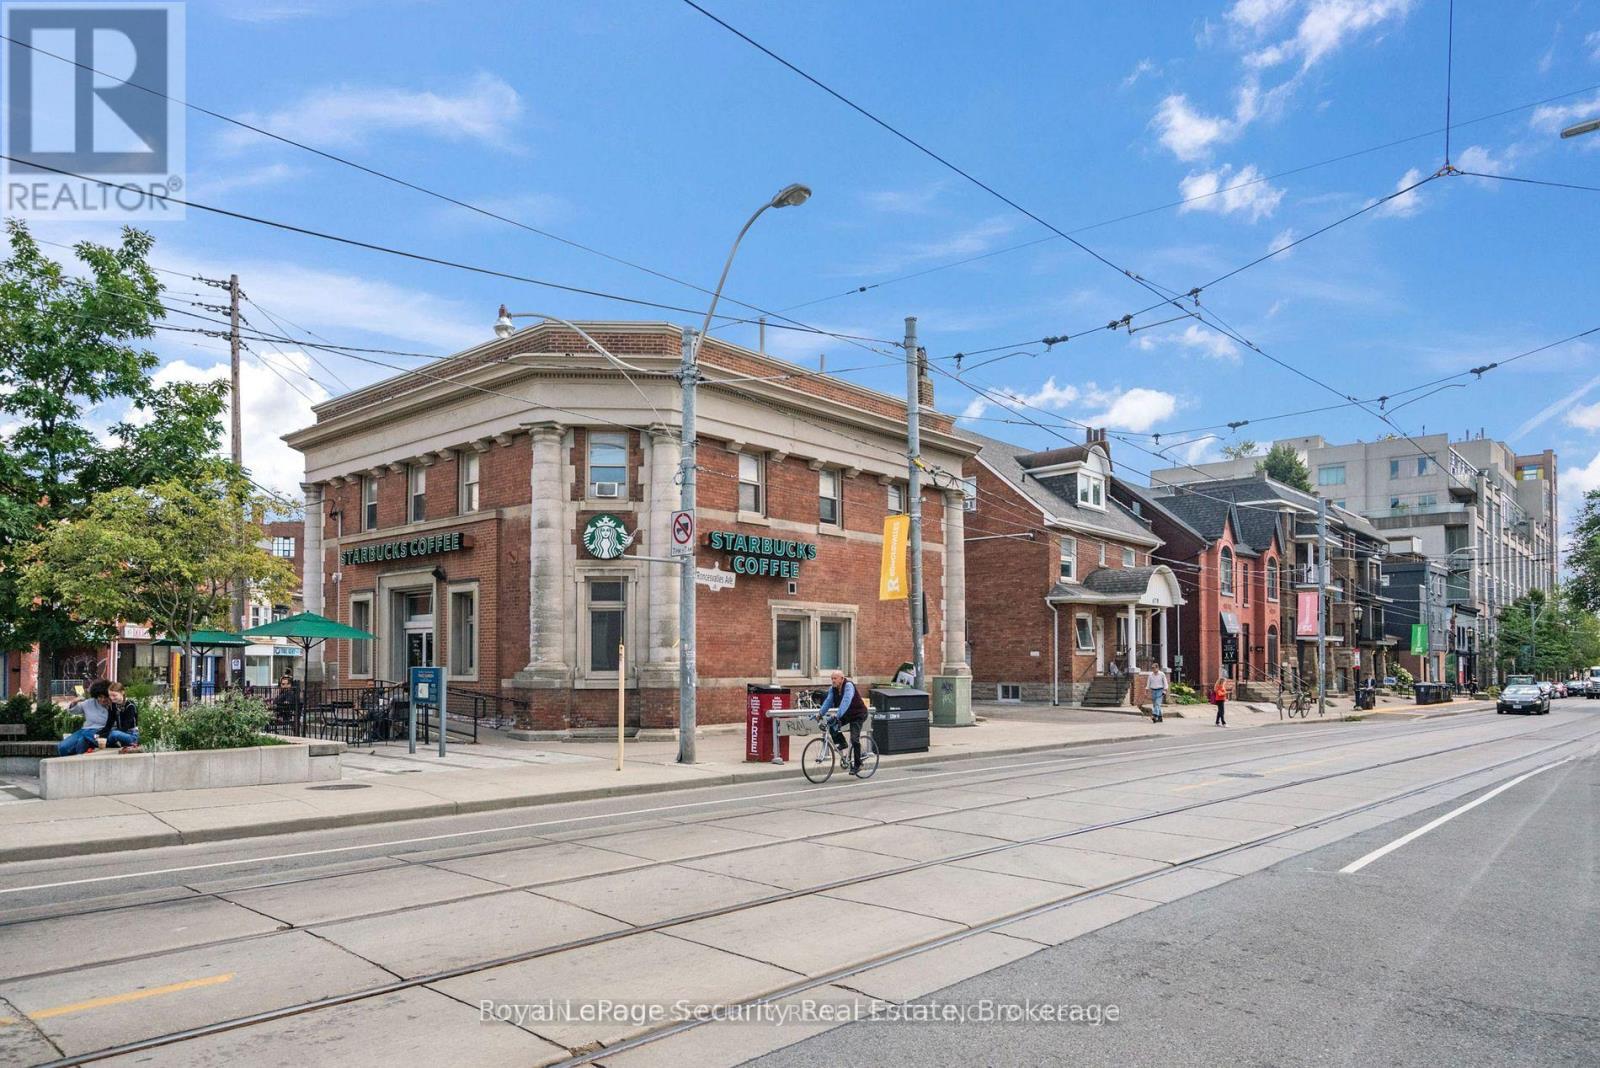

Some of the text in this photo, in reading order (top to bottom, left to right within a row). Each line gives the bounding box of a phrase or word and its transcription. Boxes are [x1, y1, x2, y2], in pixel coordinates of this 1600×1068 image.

[340, 532, 460, 566] STARBUCKS COFFEE
[711, 530, 817, 561] STARBUCKS
[733, 555, 800, 578] COFFEE
[751, 717, 759, 753] FREE
